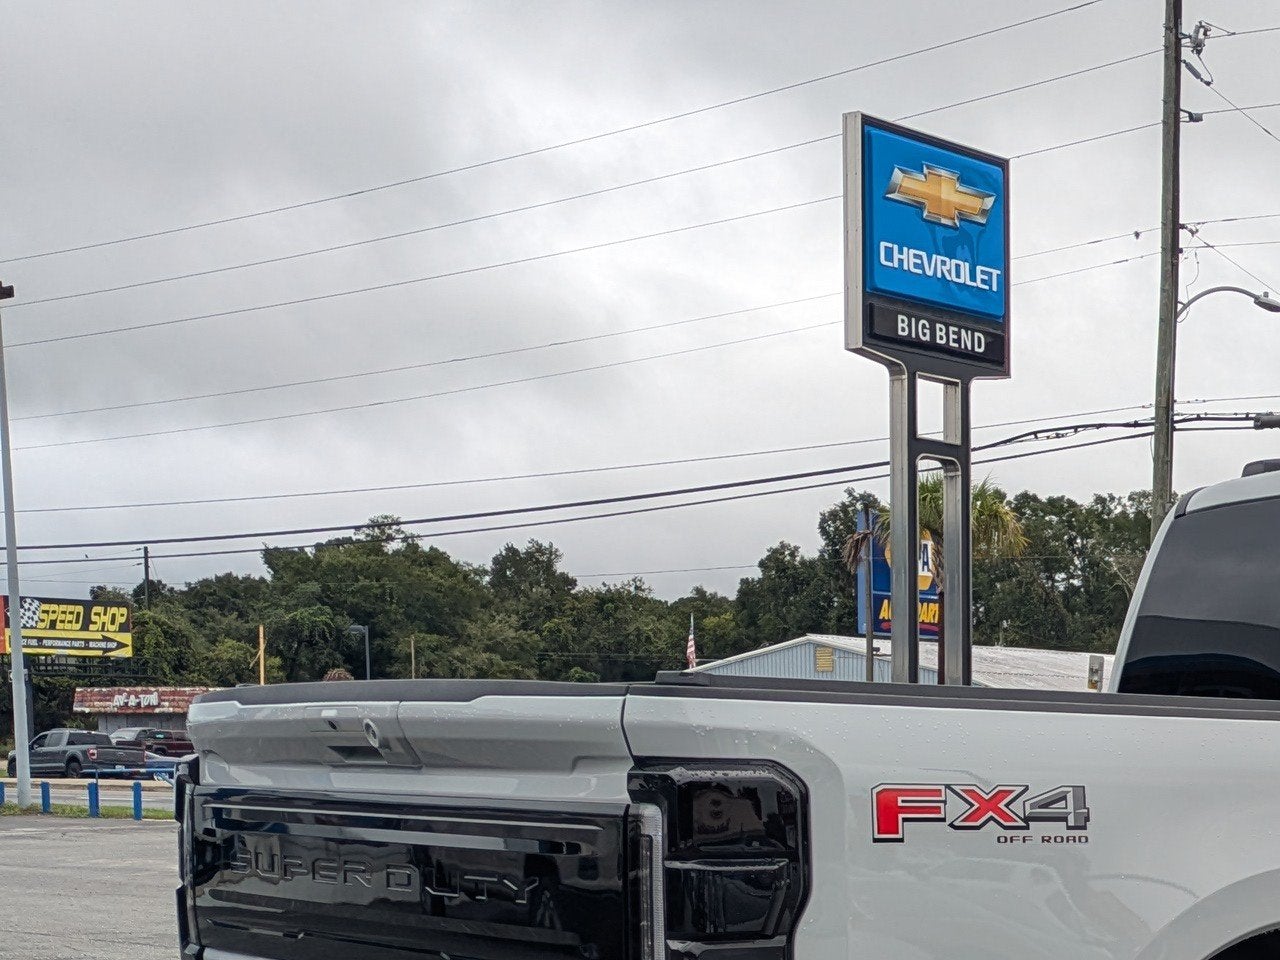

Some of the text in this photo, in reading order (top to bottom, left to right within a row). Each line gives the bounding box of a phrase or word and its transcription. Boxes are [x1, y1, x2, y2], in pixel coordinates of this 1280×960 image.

[880, 240, 1001, 292] CHEVROLET
[897, 314, 986, 353] BIG BEND
[37, 603, 128, 632] SPEED SHOP
[42, 639, 71, 648] PERFORMANCE
[71, 640, 85, 648] PARTS
[89, 641, 106, 649] MACHINE
[106, 641, 118, 649] SHOP
[870, 782, 1091, 844] FX4
[996, 835, 1089, 844] OFF ROAD
[230, 852, 539, 904] SUPER DUTY
